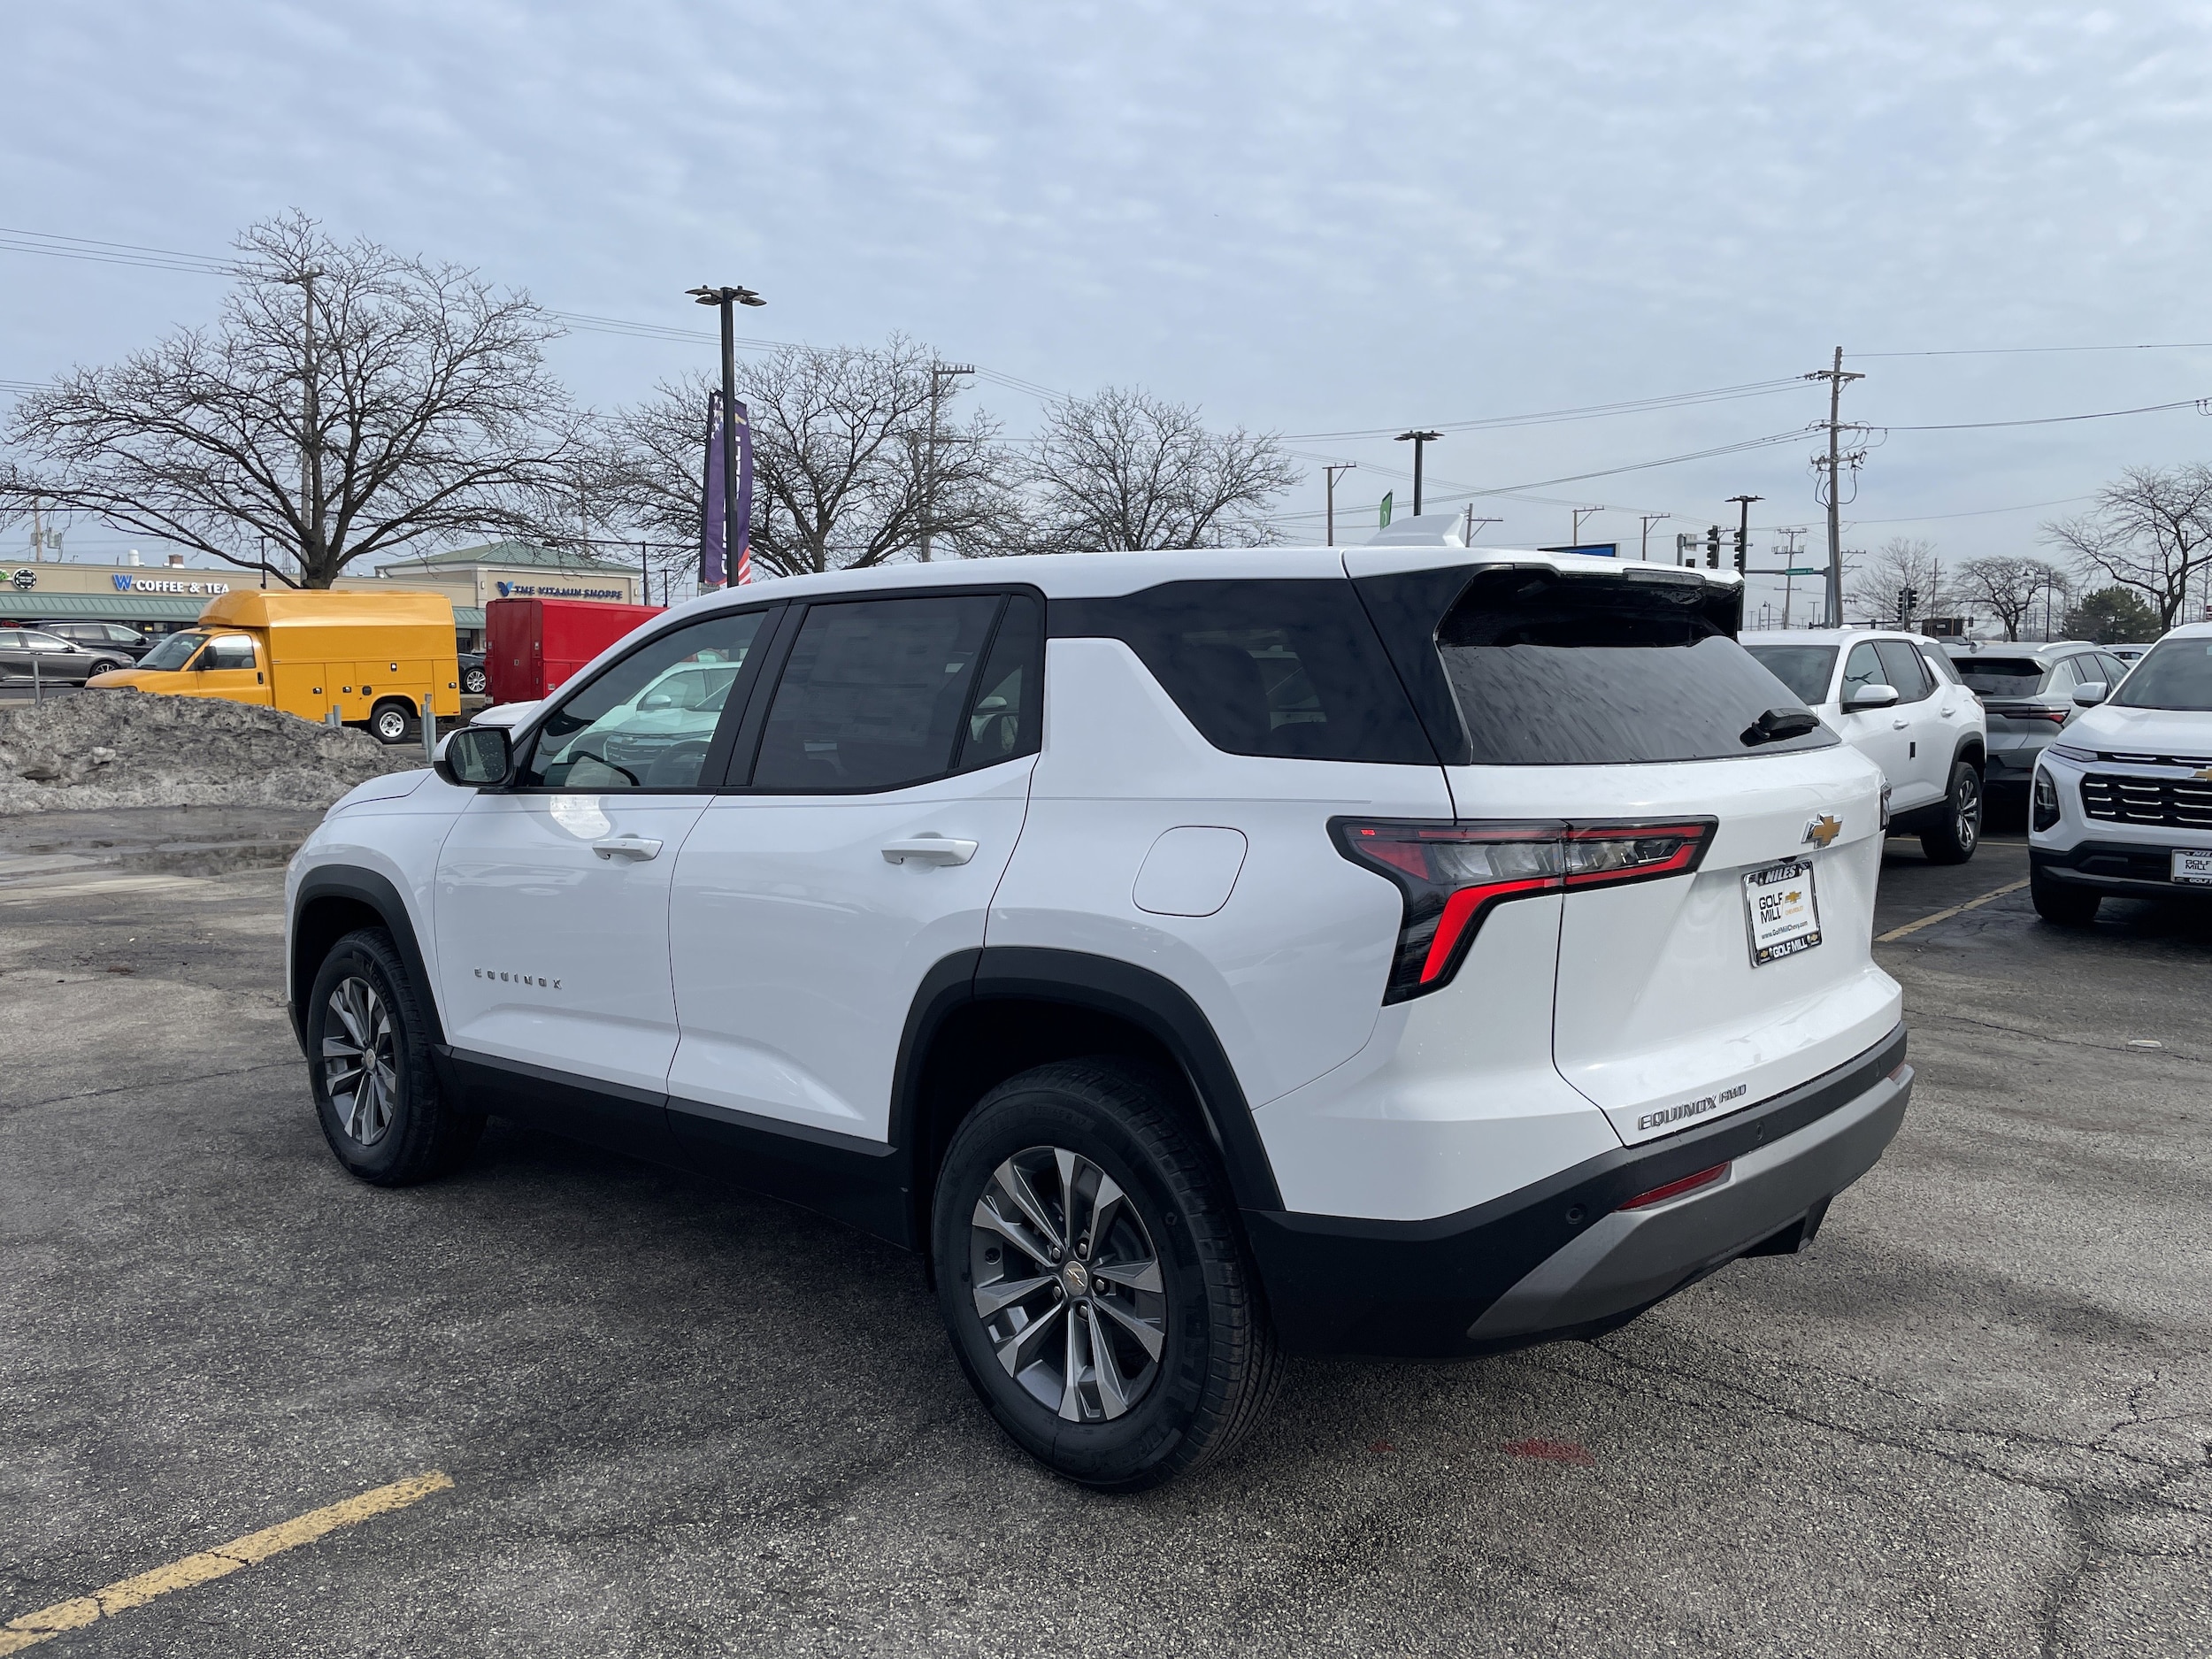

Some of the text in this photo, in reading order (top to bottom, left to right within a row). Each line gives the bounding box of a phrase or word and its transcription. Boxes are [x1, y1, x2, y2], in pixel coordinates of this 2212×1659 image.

[113, 574, 230, 594] W COFFEE & TEA
[514, 586, 623, 600] THE VITAMIN SHOPPE
[1764, 864, 1797, 884] NILES
[1759, 892, 1783, 910] GOLF
[1760, 907, 1782, 925] MILL
[1773, 938, 1808, 958] GOLF MILL
[473, 966, 563, 990] EQUINOX
[1637, 1084, 1747, 1131] EQUINOX AWD
